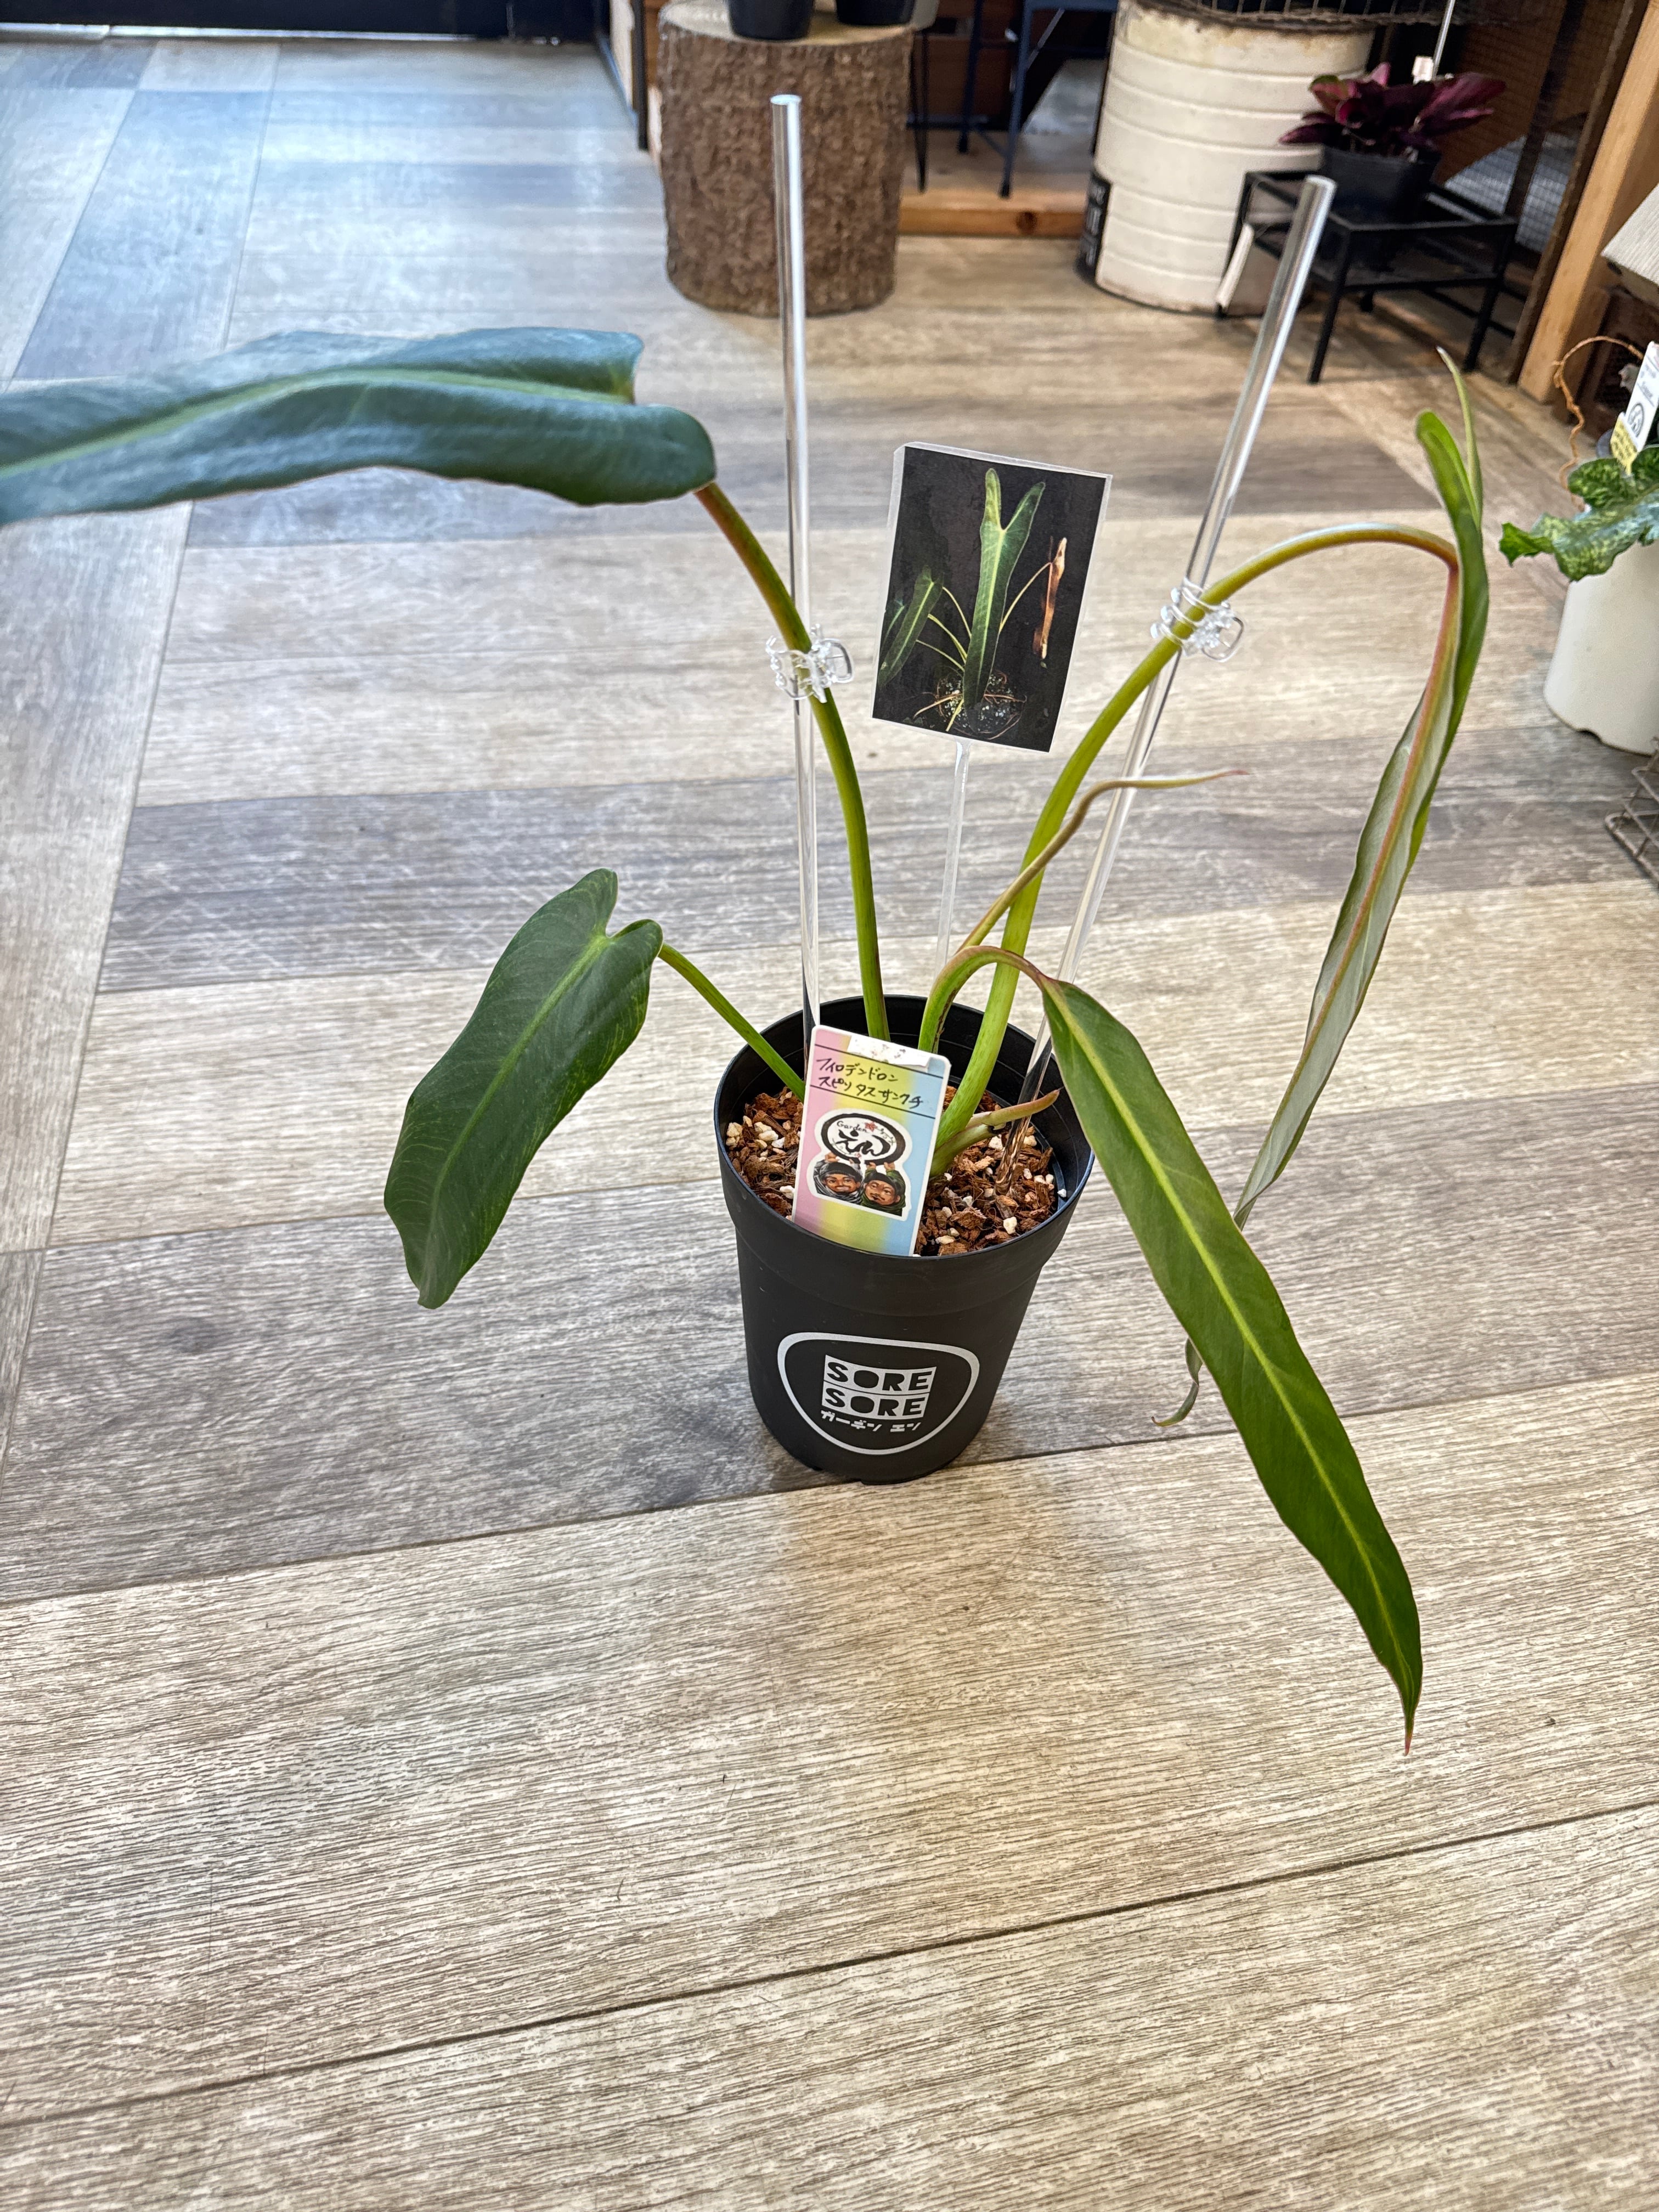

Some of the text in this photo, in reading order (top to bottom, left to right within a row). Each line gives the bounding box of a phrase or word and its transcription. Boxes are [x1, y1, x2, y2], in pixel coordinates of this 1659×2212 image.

[836, 1120, 868, 1133] Garden
[827, 1362, 933, 1391] SORE
[825, 1387, 926, 1417] SORE
